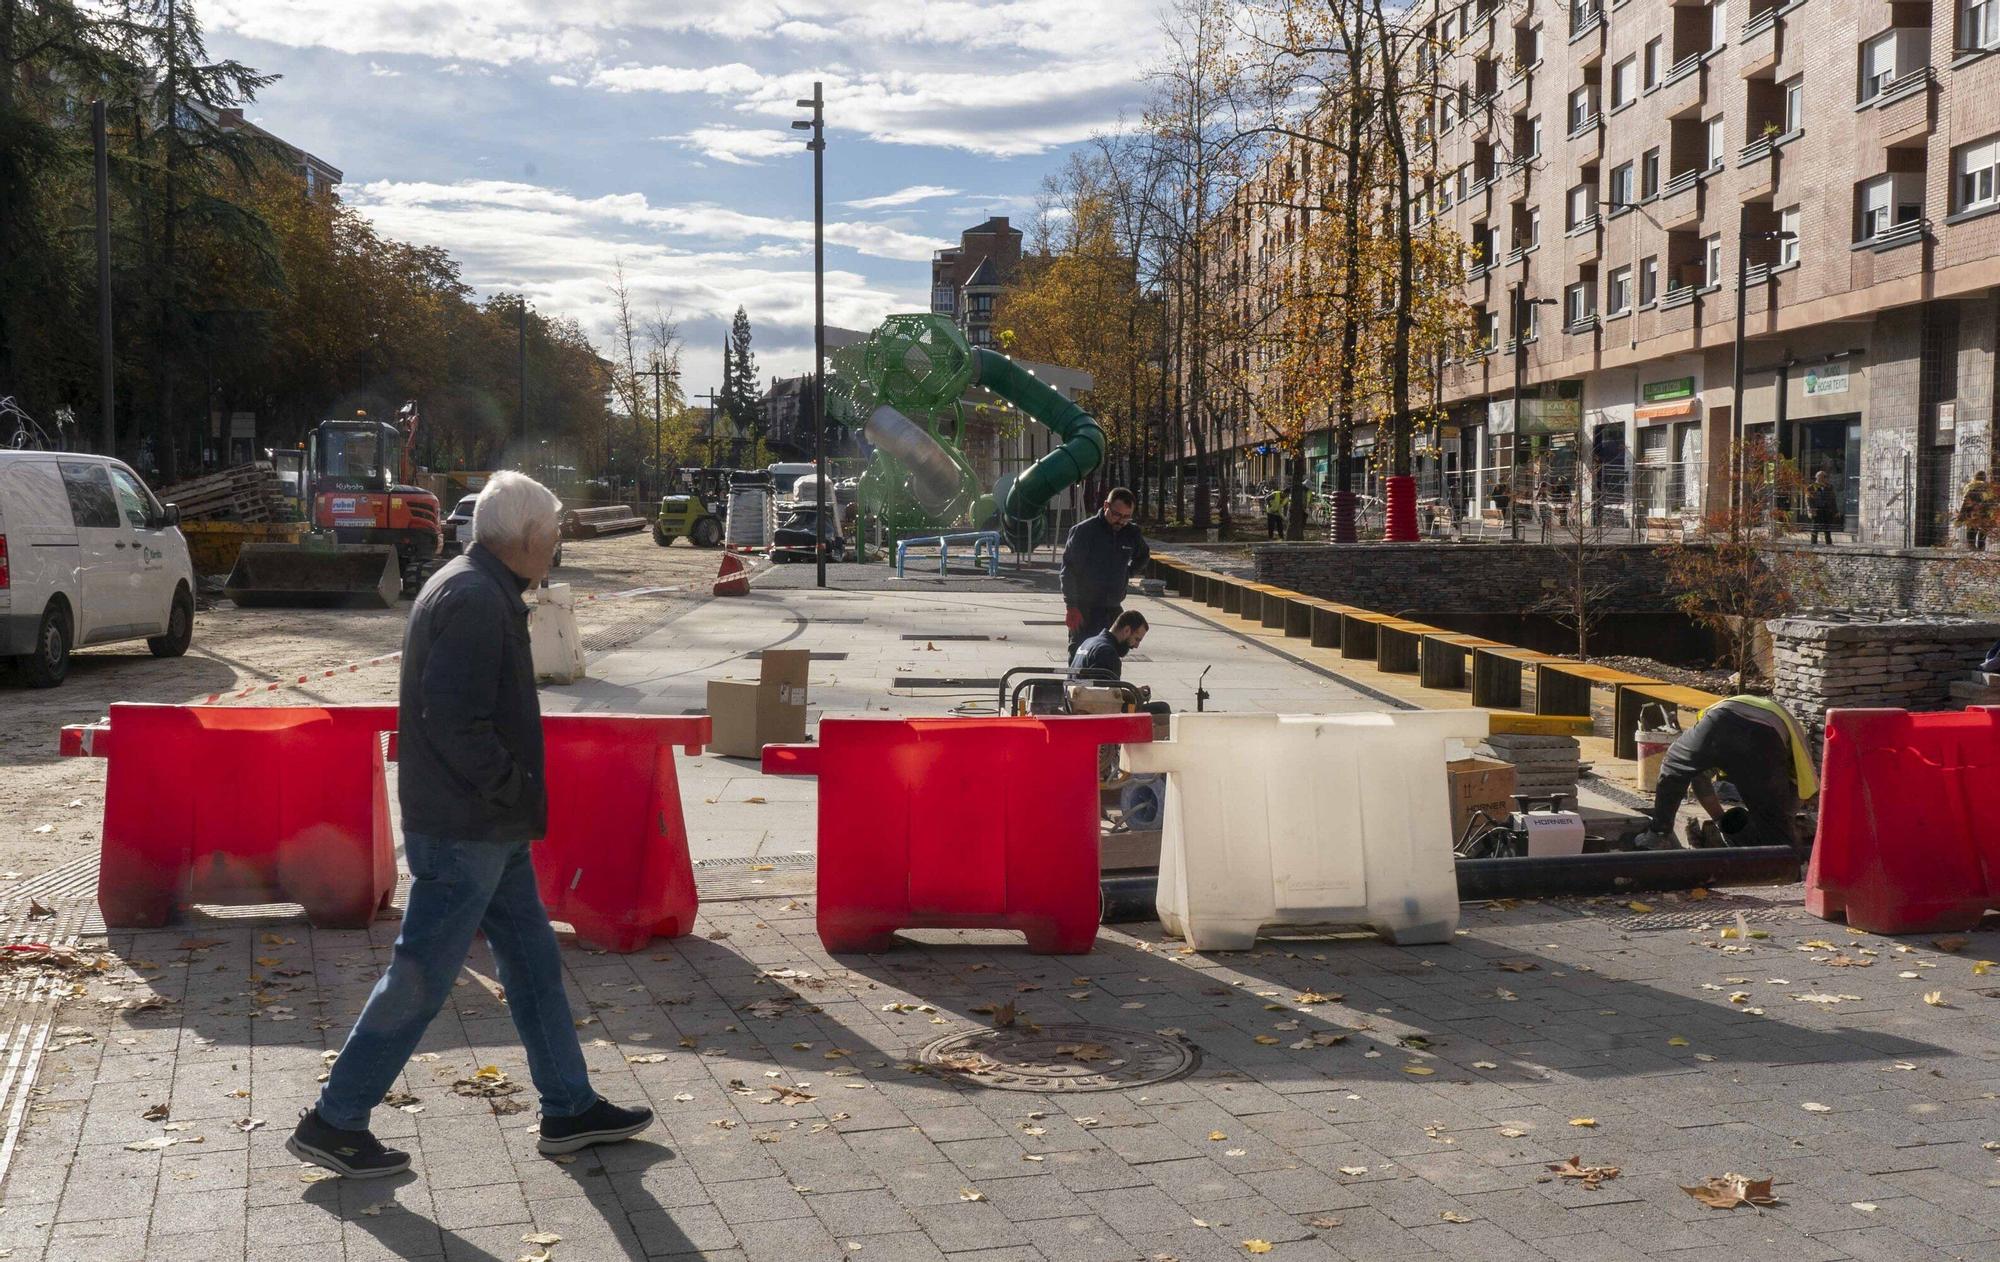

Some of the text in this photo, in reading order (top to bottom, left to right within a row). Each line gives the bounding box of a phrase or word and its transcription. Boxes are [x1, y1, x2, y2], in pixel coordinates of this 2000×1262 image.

[1823, 364, 1841, 377] MUNDO
[1817, 377, 1848, 392] HOGAR TEXTIL
[1466, 801, 1506, 813] HORNER
[1534, 818, 1574, 826] HORNER
